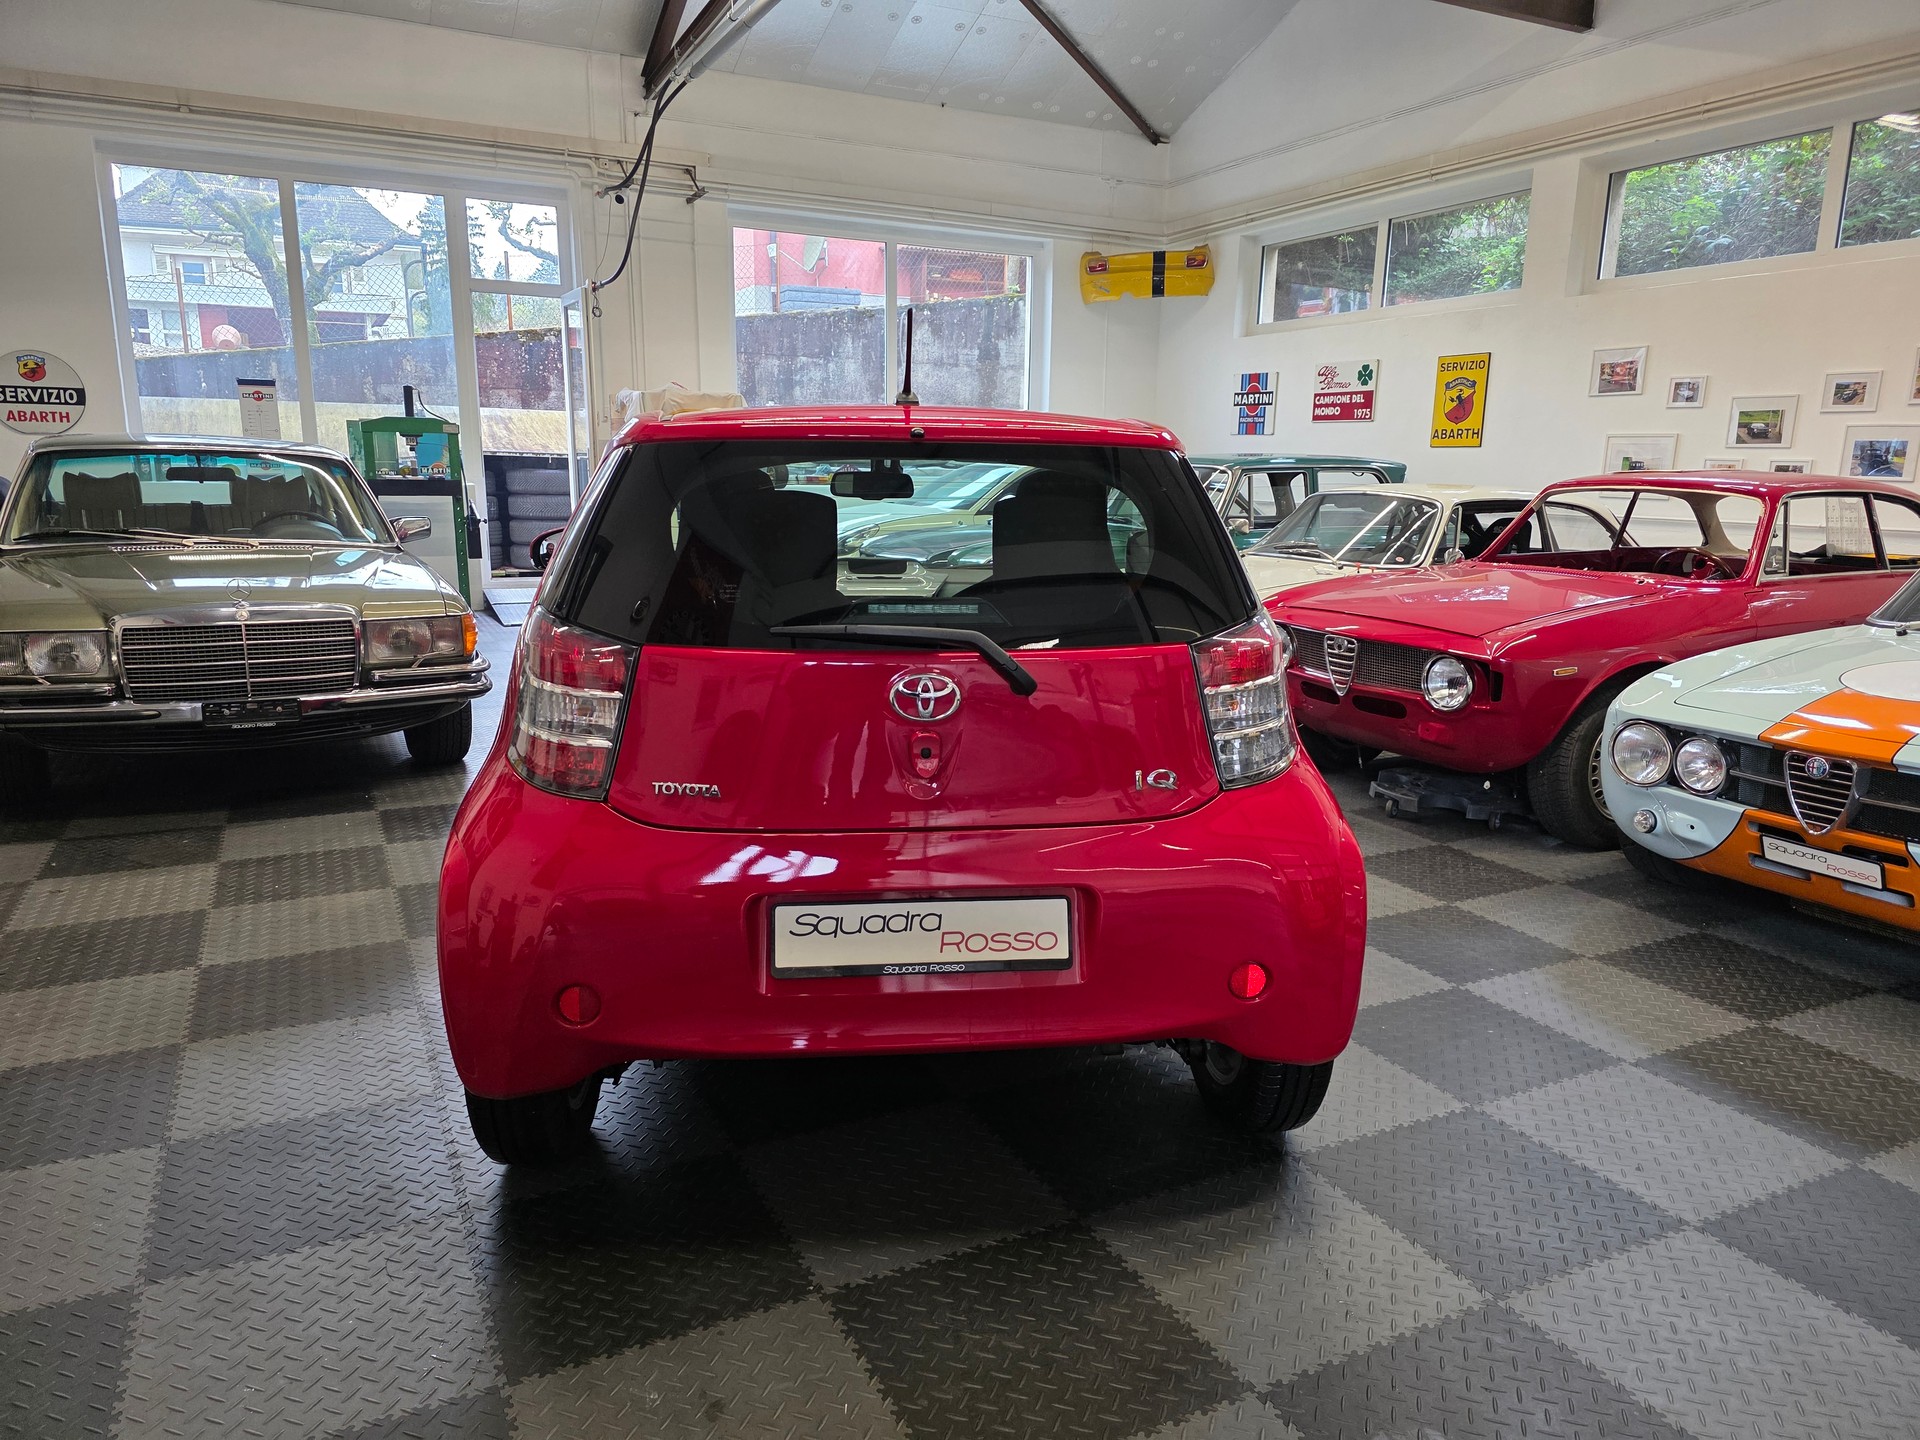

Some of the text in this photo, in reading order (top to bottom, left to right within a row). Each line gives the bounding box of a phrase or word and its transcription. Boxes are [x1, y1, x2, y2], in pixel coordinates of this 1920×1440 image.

[1317, 365, 1340, 379] Alfa
[1440, 359, 1486, 372] SERVIZIO
[1319, 377, 1351, 390] Romeo
[1234, 393, 1273, 405] MARTINI
[1315, 394, 1365, 405] CAMPIONE DEL
[6, 410, 71, 423] ABARTH
[1314, 407, 1371, 419] MONDO 1975
[1432, 428, 1480, 440] ABARTH
[652, 782, 721, 797] TOYOTA
[1767, 841, 1828, 864] Squadra
[789, 911, 943, 938] Squadra
[883, 965, 928, 974] Squadra
